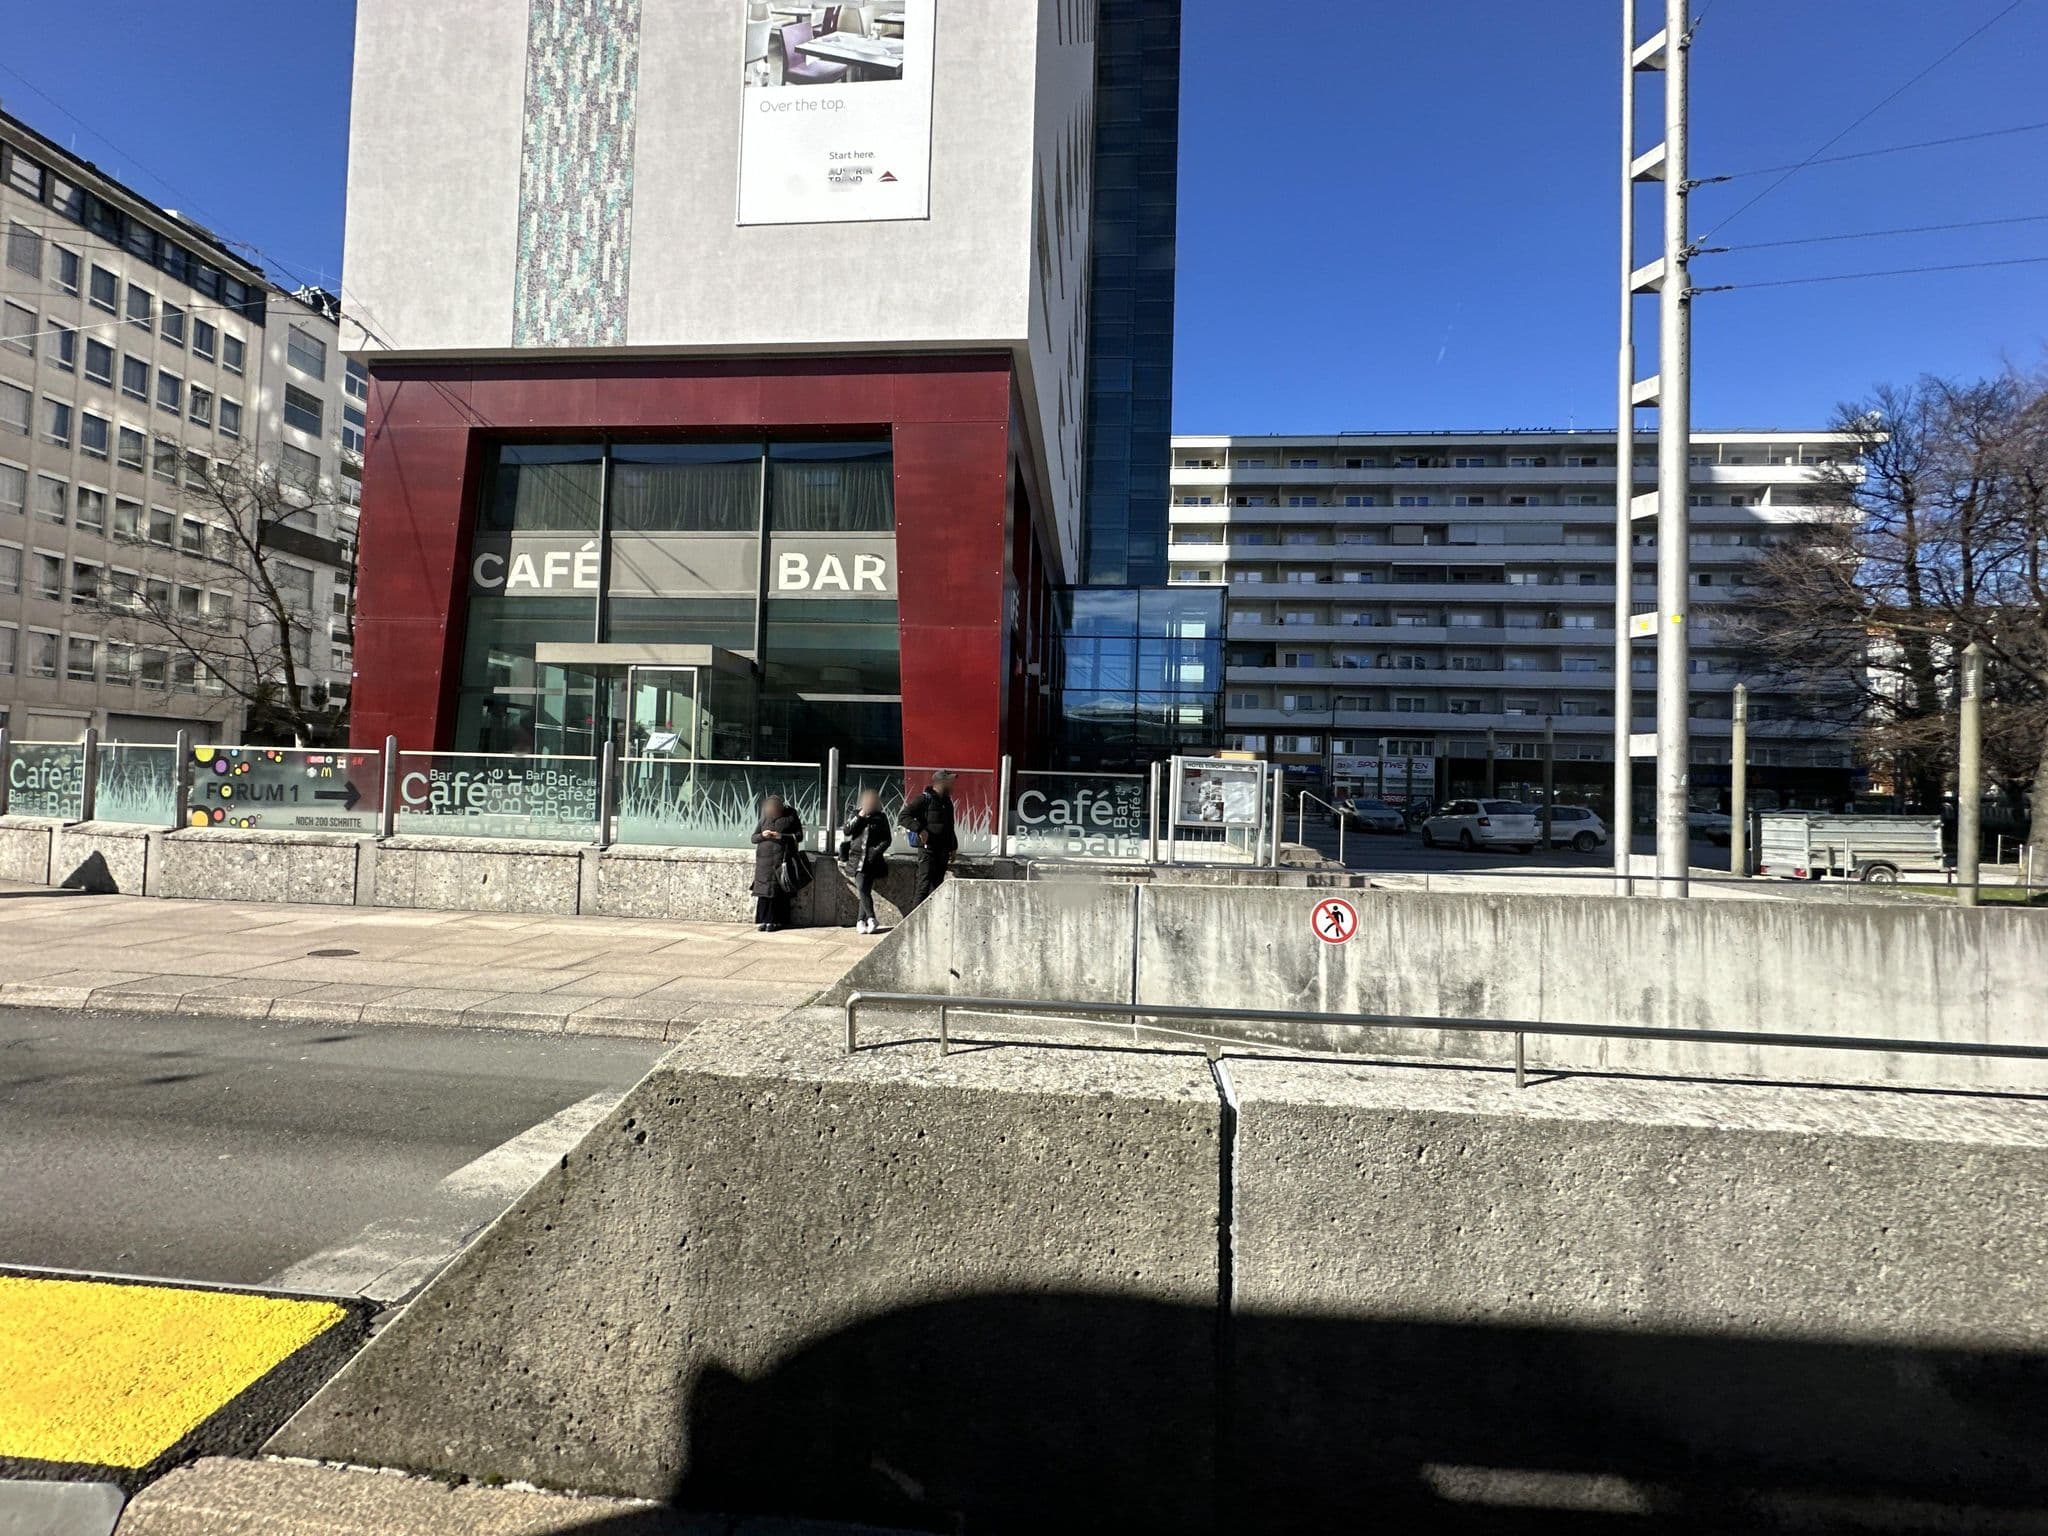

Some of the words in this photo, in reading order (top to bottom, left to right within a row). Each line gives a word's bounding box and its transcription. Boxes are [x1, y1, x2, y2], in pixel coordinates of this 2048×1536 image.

[760, 100, 792, 112] Over
[795, 99, 818, 111] the
[822, 98, 846, 112] top.
[829, 151, 852, 160] Start
[854, 150, 875, 159] here.
[473, 540, 600, 588] CAFÉ
[778, 552, 888, 591] BAR
[10, 757, 62, 790] Café
[430, 769, 452, 781] Bar
[526, 770, 545, 780] Bar
[546, 770, 577, 787] Bar
[9, 789, 26, 803] Bar
[206, 782, 284, 802] FORUM
[290, 784, 300, 802] 1
[401, 771, 488, 806] Café
[487, 768, 504, 813] Café
[502, 769, 523, 813] Bar
[546, 785, 583, 801] Café
[47, 791, 81, 818] Bar
[545, 800, 584, 820] Bar
[1017, 789, 1114, 826] Café
[1113, 796, 1129, 828] Bar
[1129, 797, 1141, 828] Café
[295, 816, 314, 826] NOCH
[315, 817, 329, 827] 200
[330, 817, 362, 828] SCHRITTE
[1063, 825, 1129, 857] Bar
[1126, 829, 1140, 857] Bar
